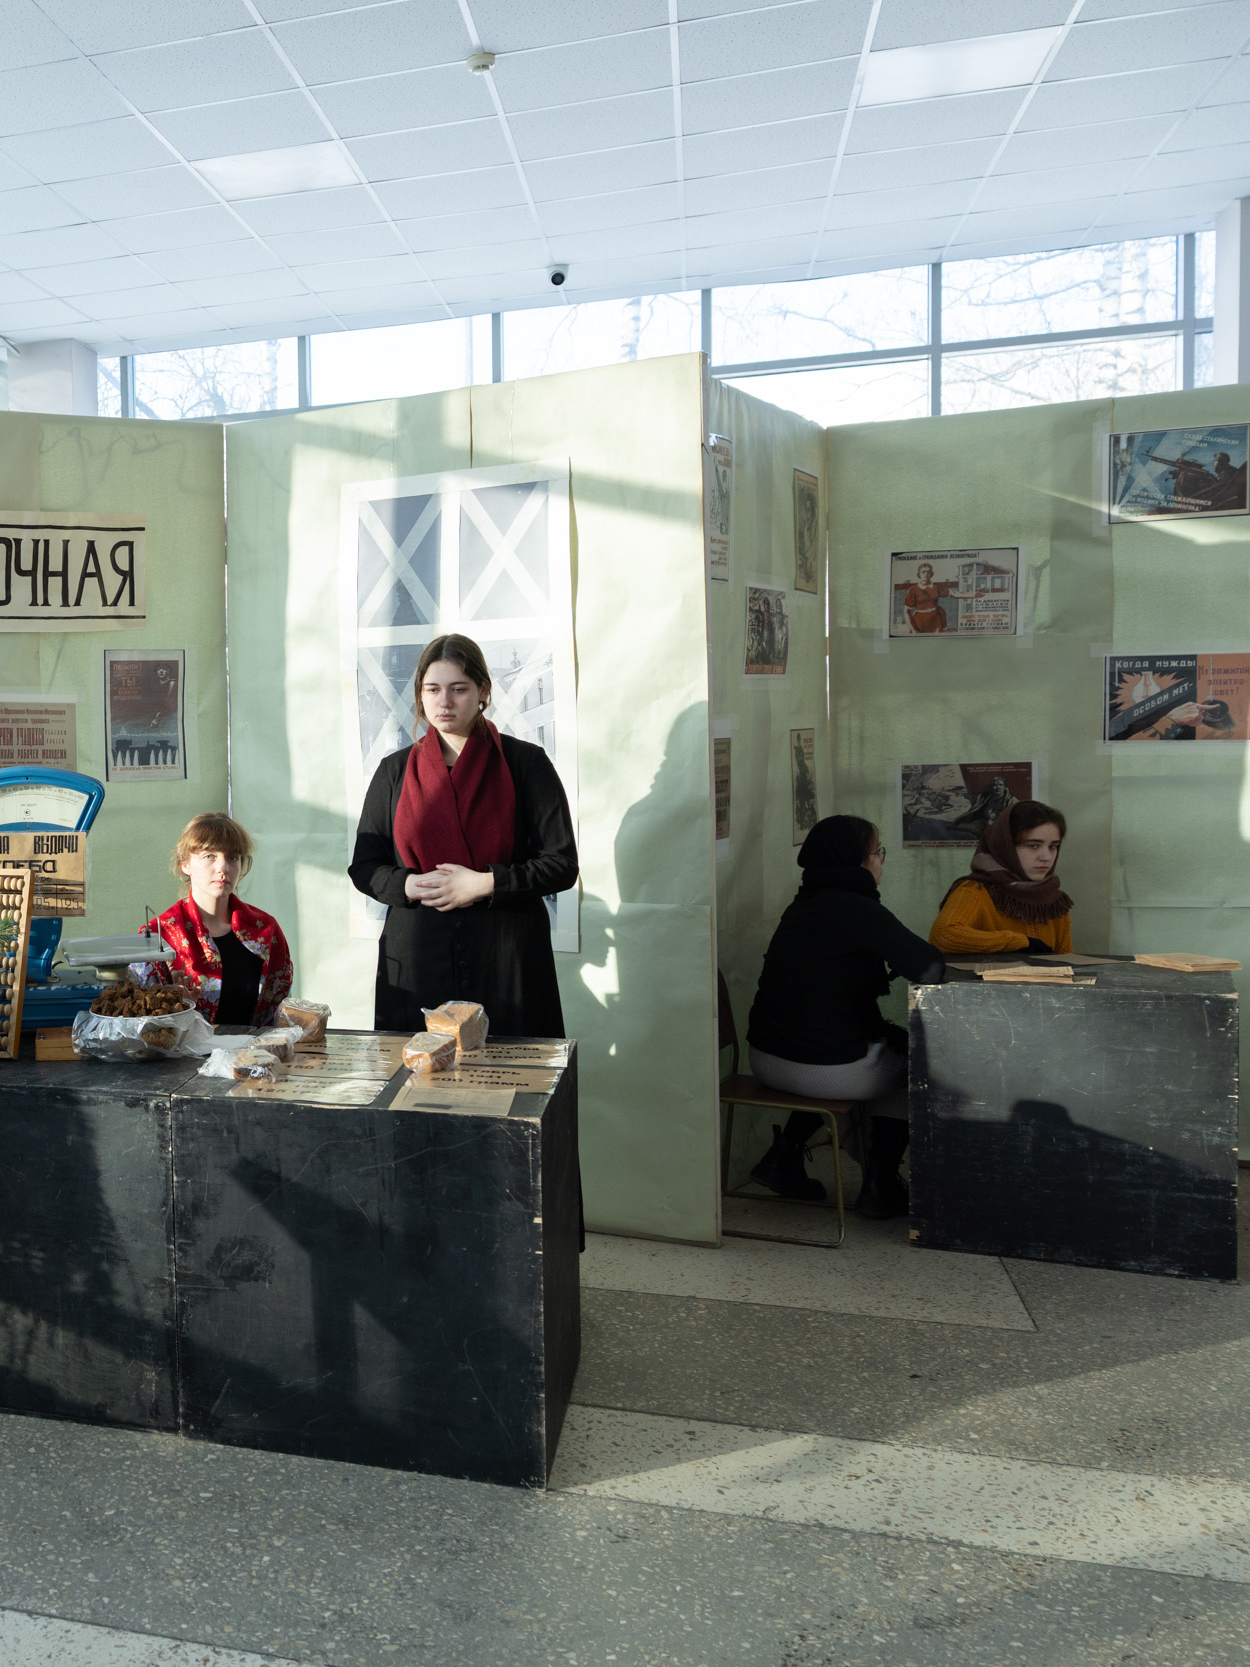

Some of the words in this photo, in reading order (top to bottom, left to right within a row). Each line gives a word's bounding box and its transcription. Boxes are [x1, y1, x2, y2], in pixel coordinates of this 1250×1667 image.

[121, 676, 136, 687] ТЫ
[1133, 694, 1169, 717] ОСОБОЙ
[33, 835, 79, 855] ВЫДАЧИ
